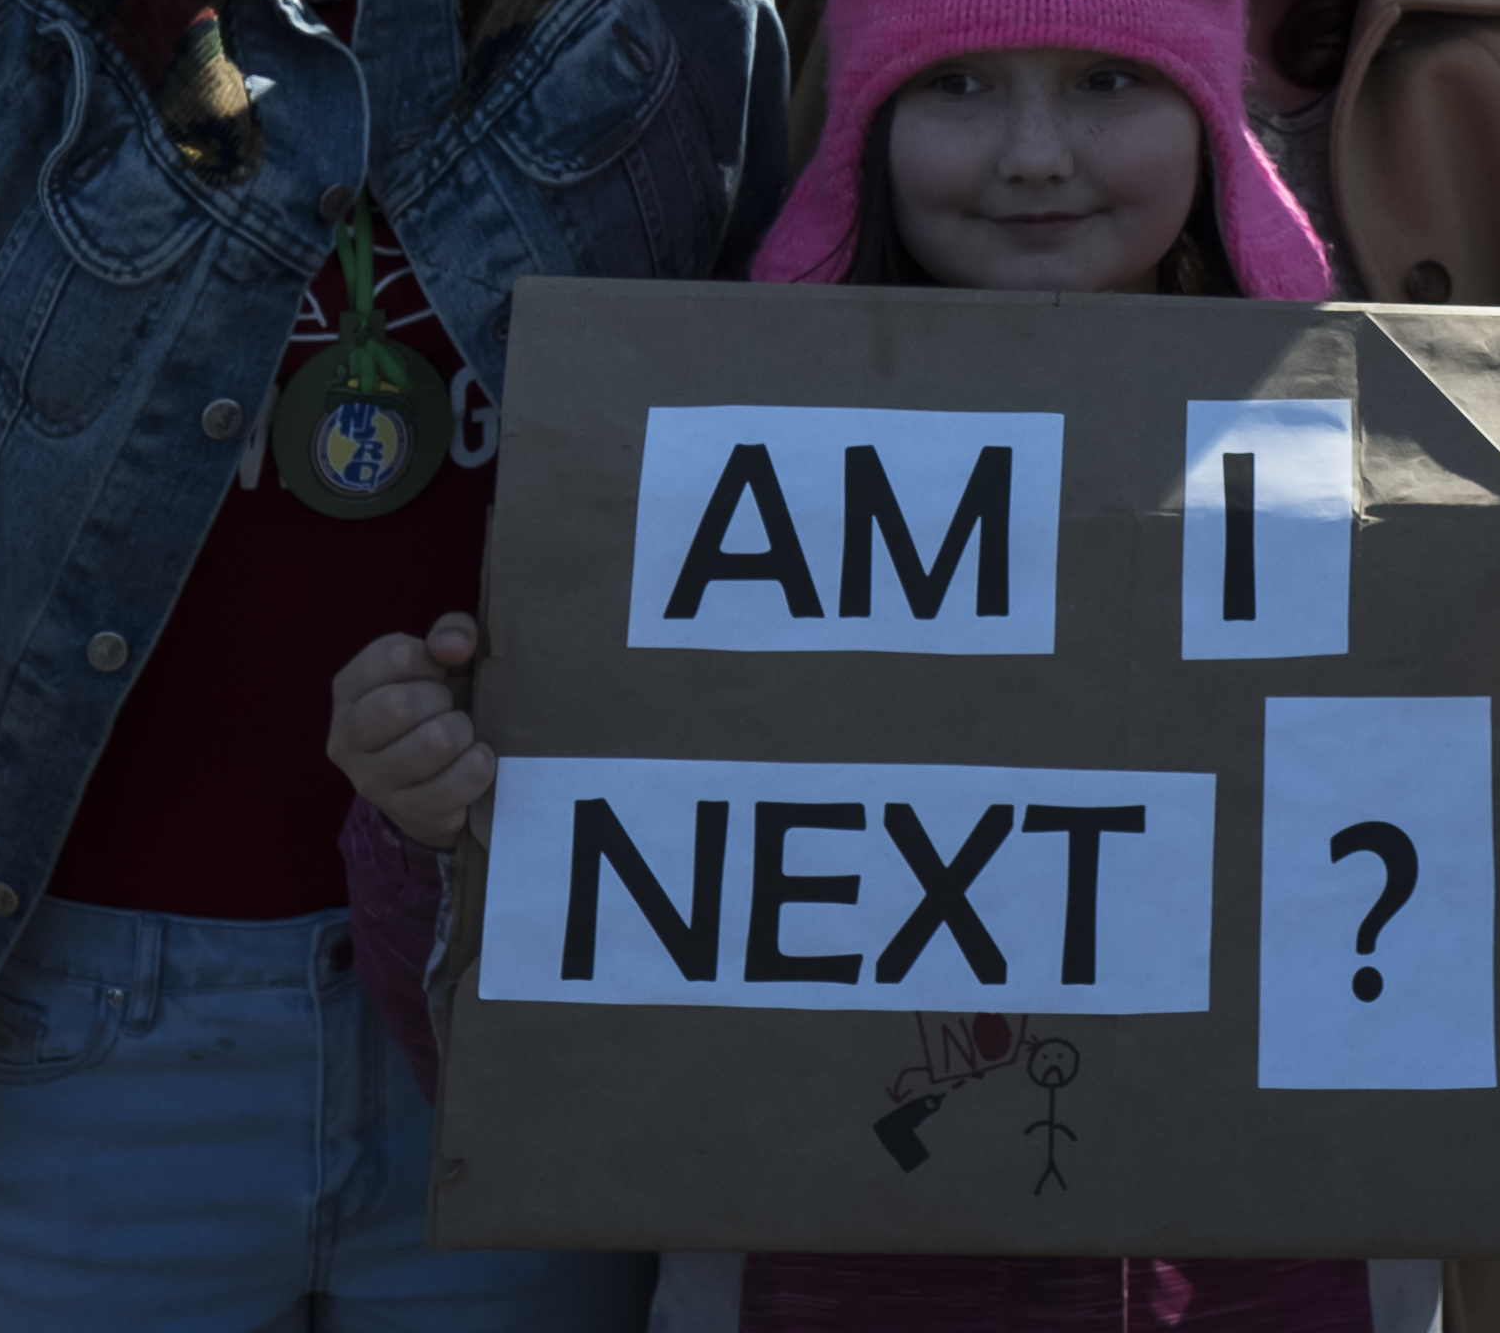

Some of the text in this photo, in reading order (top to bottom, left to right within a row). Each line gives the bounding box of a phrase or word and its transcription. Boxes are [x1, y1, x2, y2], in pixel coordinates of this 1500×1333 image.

[662, 442, 1256, 622] AM I
[560, 798, 1420, 1004] NEXT ?
